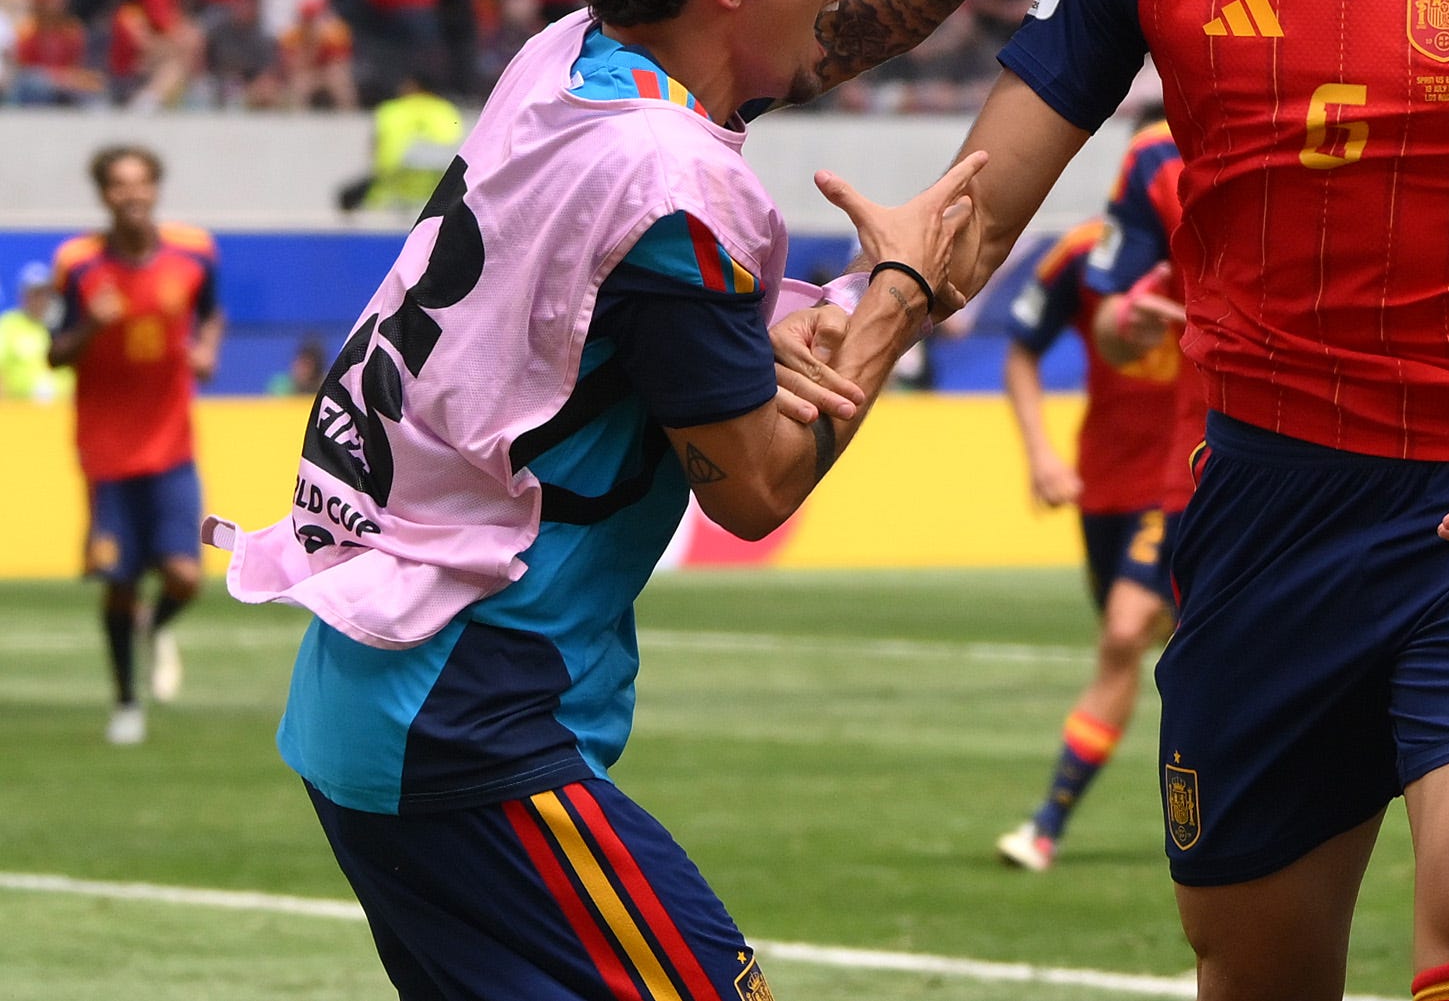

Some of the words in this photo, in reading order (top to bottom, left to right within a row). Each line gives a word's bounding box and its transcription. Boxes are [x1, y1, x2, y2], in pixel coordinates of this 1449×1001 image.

[1416, 76, 1434, 84] SPAIN
[1424, 94, 1436, 102] LOS
[1299, 83, 1369, 169] 6
[327, 496, 382, 538] CUP
